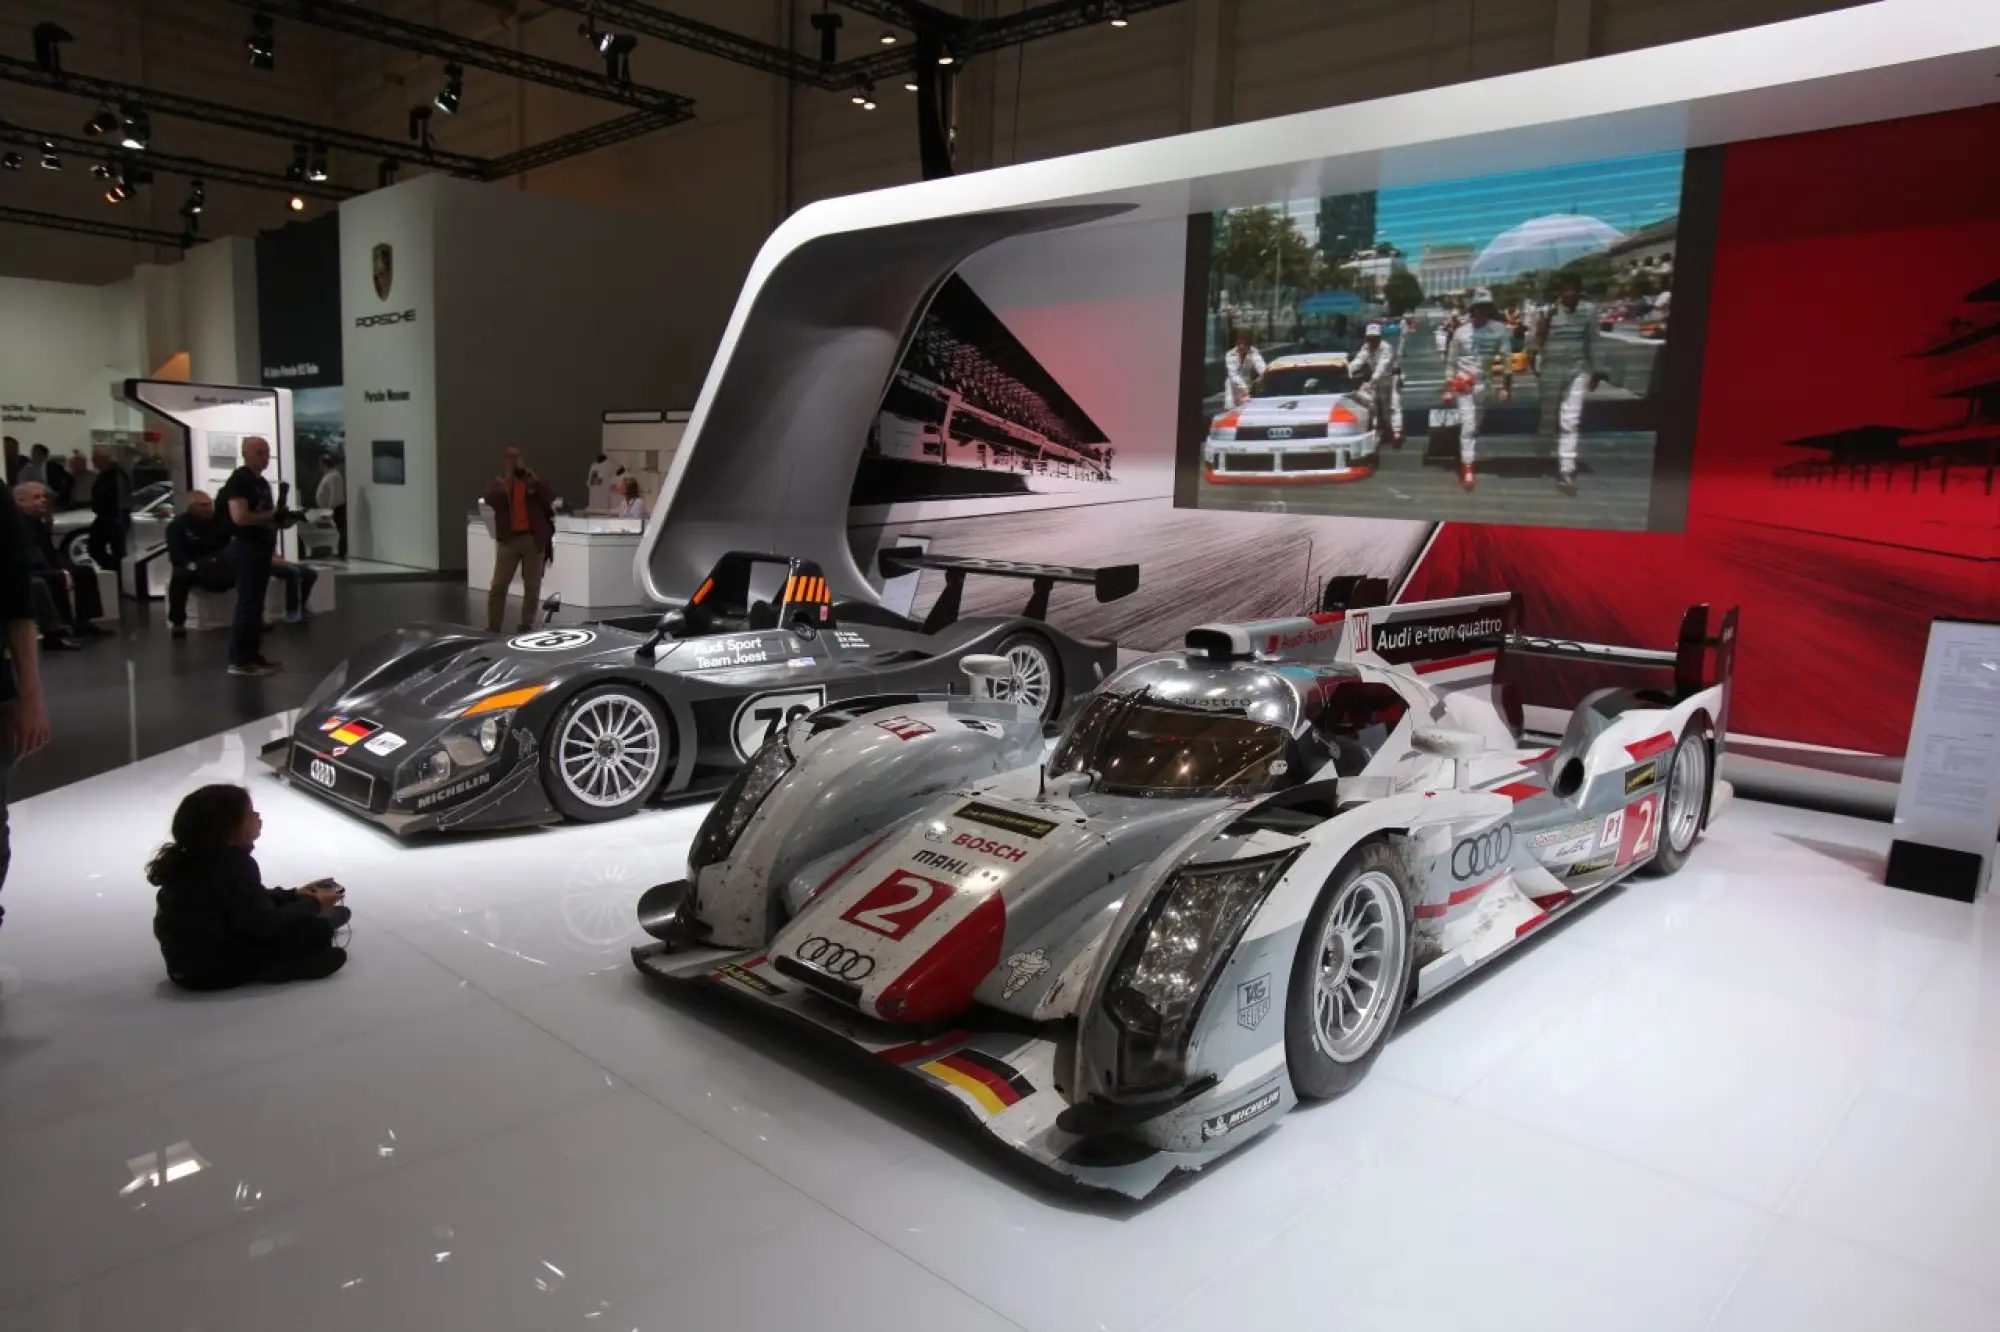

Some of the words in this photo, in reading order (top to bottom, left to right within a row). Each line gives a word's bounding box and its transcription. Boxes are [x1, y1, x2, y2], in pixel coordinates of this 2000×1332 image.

[356, 308, 416, 327] PORSCHE
[693, 640, 725, 655] Audi
[727, 637, 762, 654] Sport
[1282, 632, 1304, 649] Audi
[1306, 628, 1333, 646] Sport
[1376, 626, 1412, 650] Audi
[1415, 625, 1454, 646] e-tron
[1457, 618, 1502, 642] quattro
[697, 656, 731, 668] Team
[733, 651, 767, 664] Joest
[416, 773, 490, 809] MICHELIN
[1604, 815, 1621, 843] P1
[1633, 800, 1652, 857] 2
[951, 833, 1028, 863] BOSCH
[856, 877, 934, 932] 2
[1244, 980, 1266, 1004] TAG
[1240, 1001, 1268, 1026] HEUER
[1229, 1090, 1279, 1124] MICHELIN
